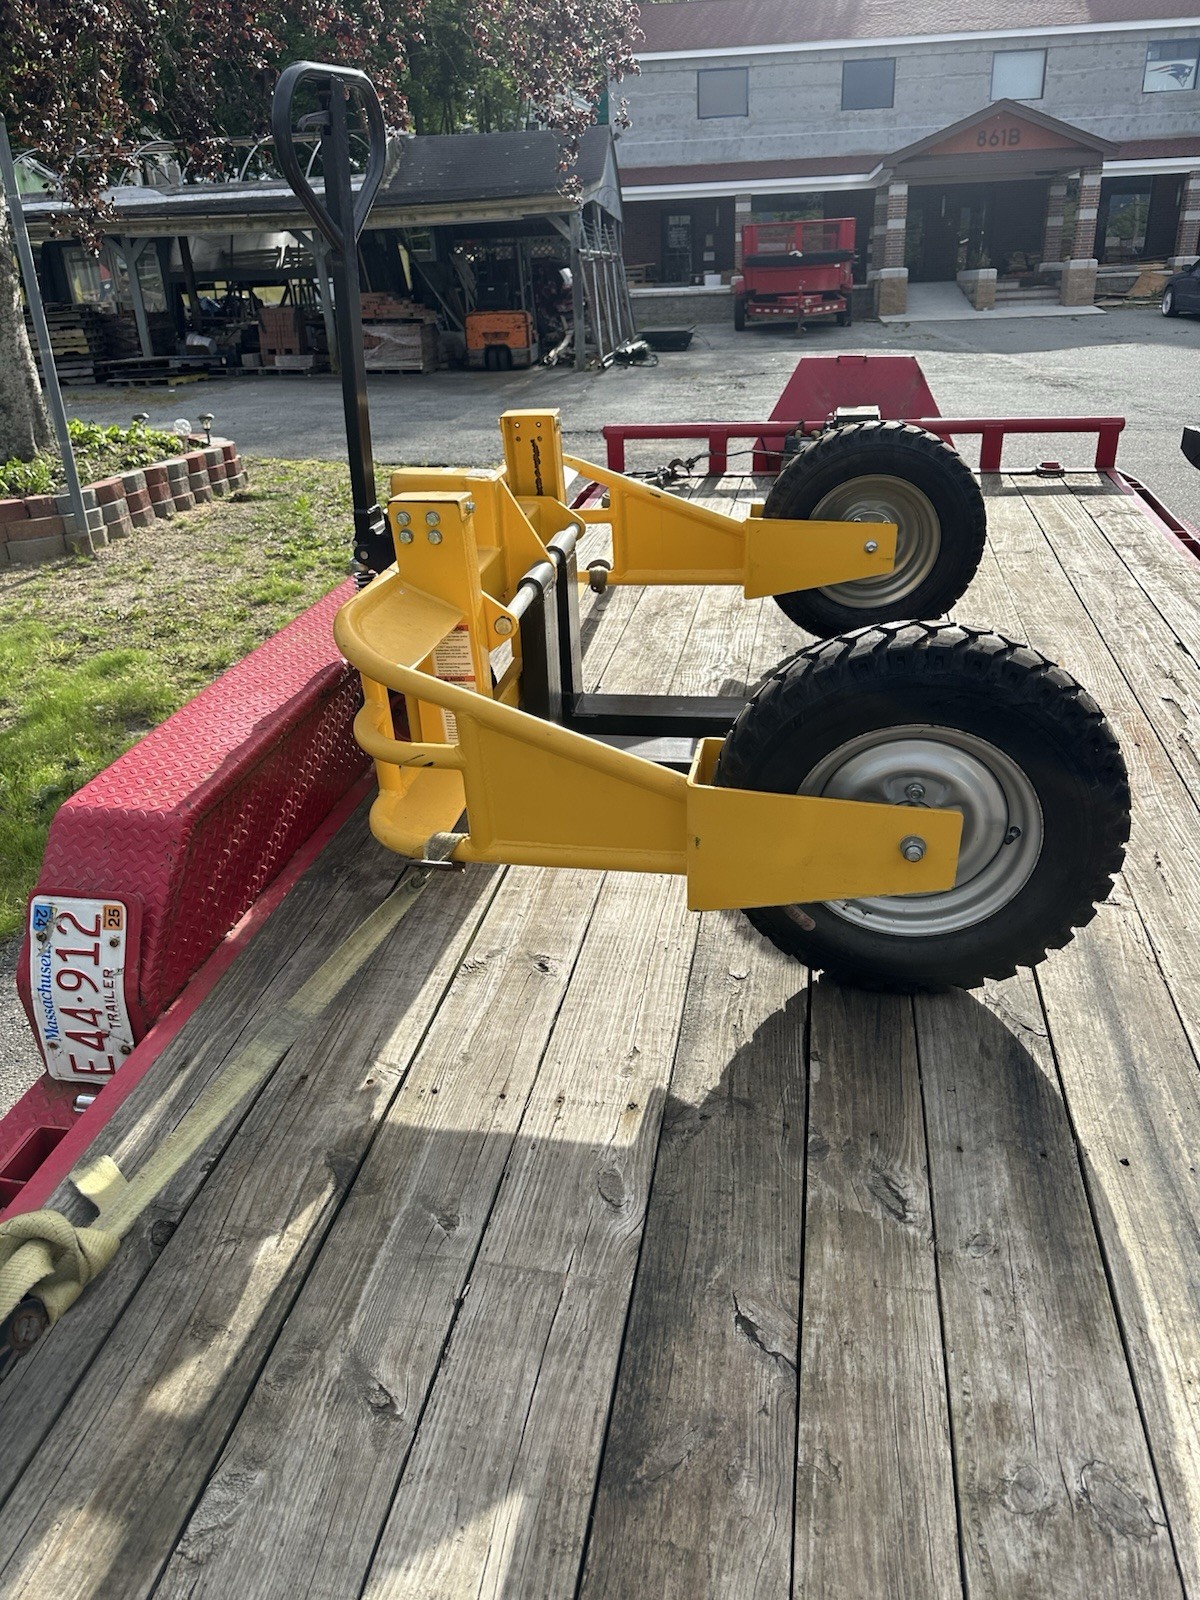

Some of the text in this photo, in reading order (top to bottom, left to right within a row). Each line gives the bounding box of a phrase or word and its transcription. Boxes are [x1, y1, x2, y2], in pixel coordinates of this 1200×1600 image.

[977, 128, 1020, 147] 861B
[35, 908, 48, 927] 24
[108, 908, 120, 928] 25
[37, 940, 62, 1041] Massachuset
[103, 968, 121, 1029] TRAILER
